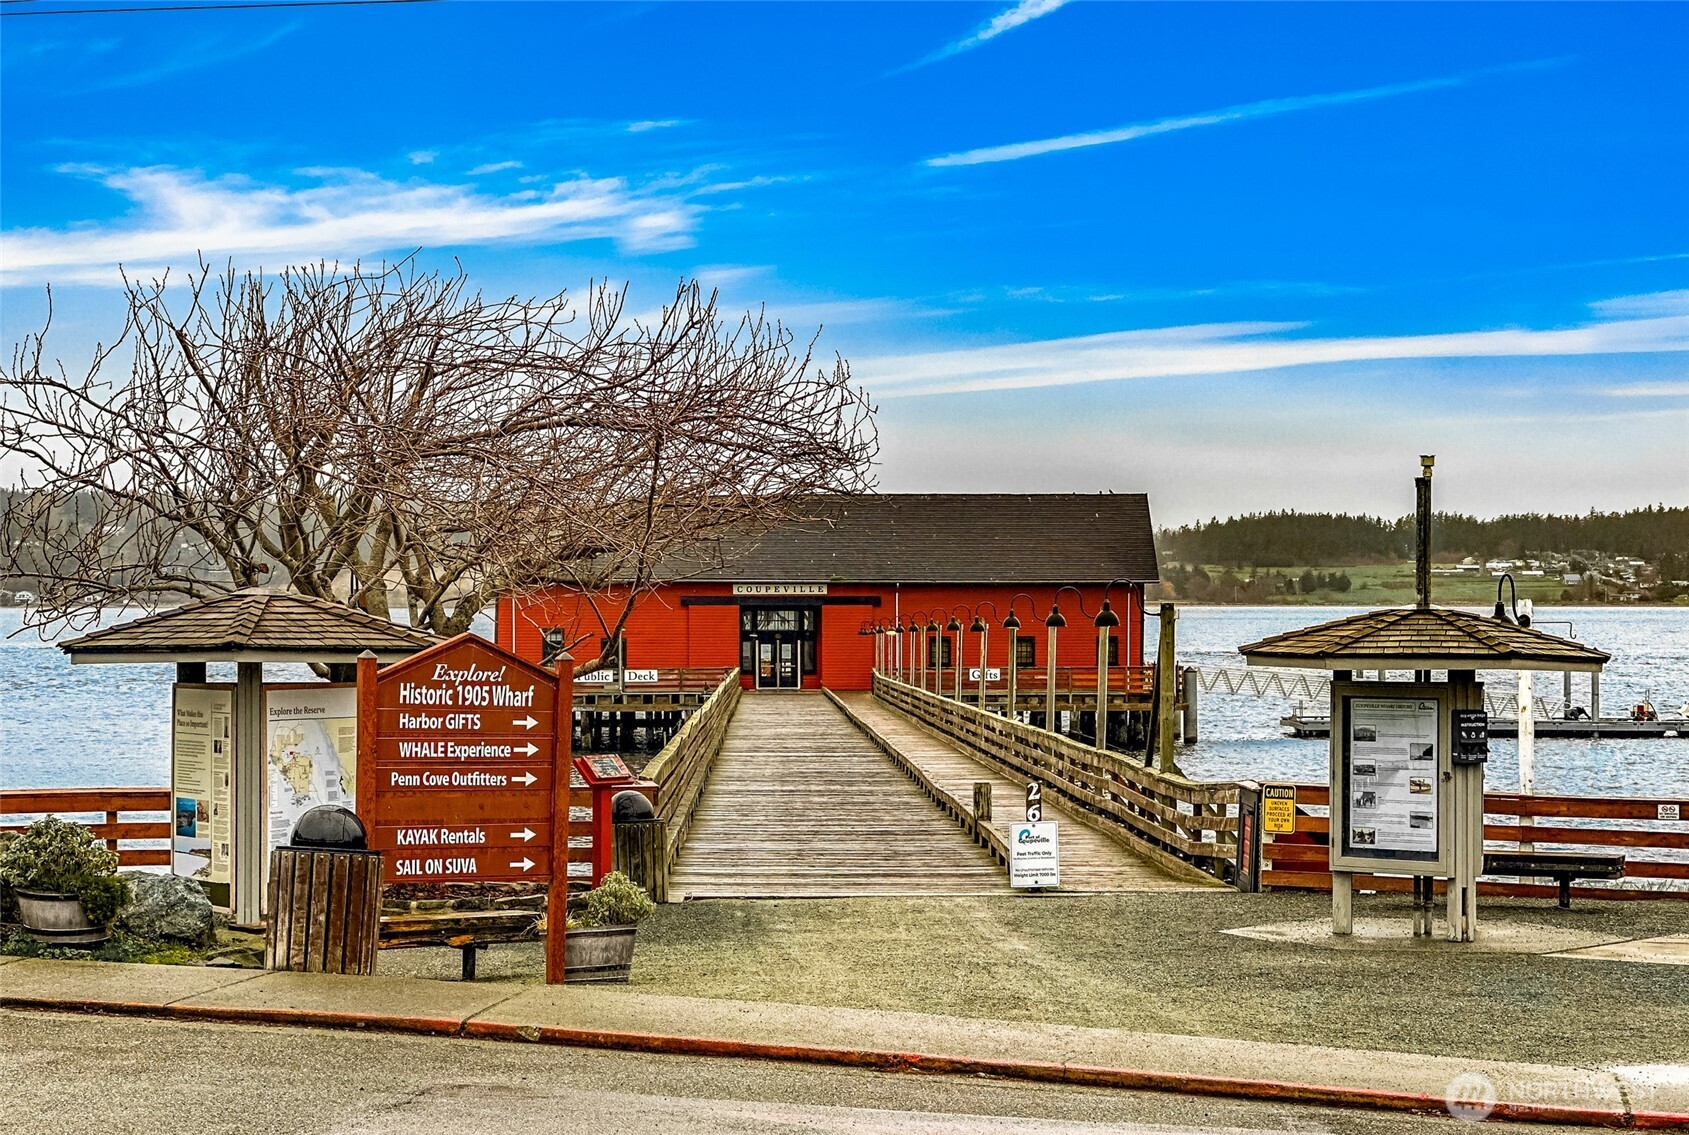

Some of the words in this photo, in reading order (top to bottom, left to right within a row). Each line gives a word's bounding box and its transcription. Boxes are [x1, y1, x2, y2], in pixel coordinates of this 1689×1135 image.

[737, 585, 824, 593] COUPEVILLE
[431, 663, 507, 686] Explore!
[628, 671, 655, 681] Deck
[972, 669, 998, 680] Gfts
[400, 683, 453, 706] Historic
[456, 686, 490, 707] 1905
[492, 685, 535, 707] Wharf
[269, 706, 292, 717] Explore
[293, 706, 303, 715] the
[303, 706, 326, 714] Reserve
[400, 713, 444, 730] Harbor
[446, 714, 481, 730] GIFTS
[399, 742, 445, 758] WHALE
[447, 742, 512, 761] Experience
[391, 772, 421, 786] Penn
[422, 772, 449, 786] Cove
[452, 772, 507, 786] Outfitters
[1265, 788, 1294, 798] CAUTION
[397, 829, 439, 845] KAYAK
[441, 827, 486, 845] Rentals
[396, 859, 423, 876] SAIL
[425, 859, 444, 875] ON
[445, 858, 477, 874] SUVA
